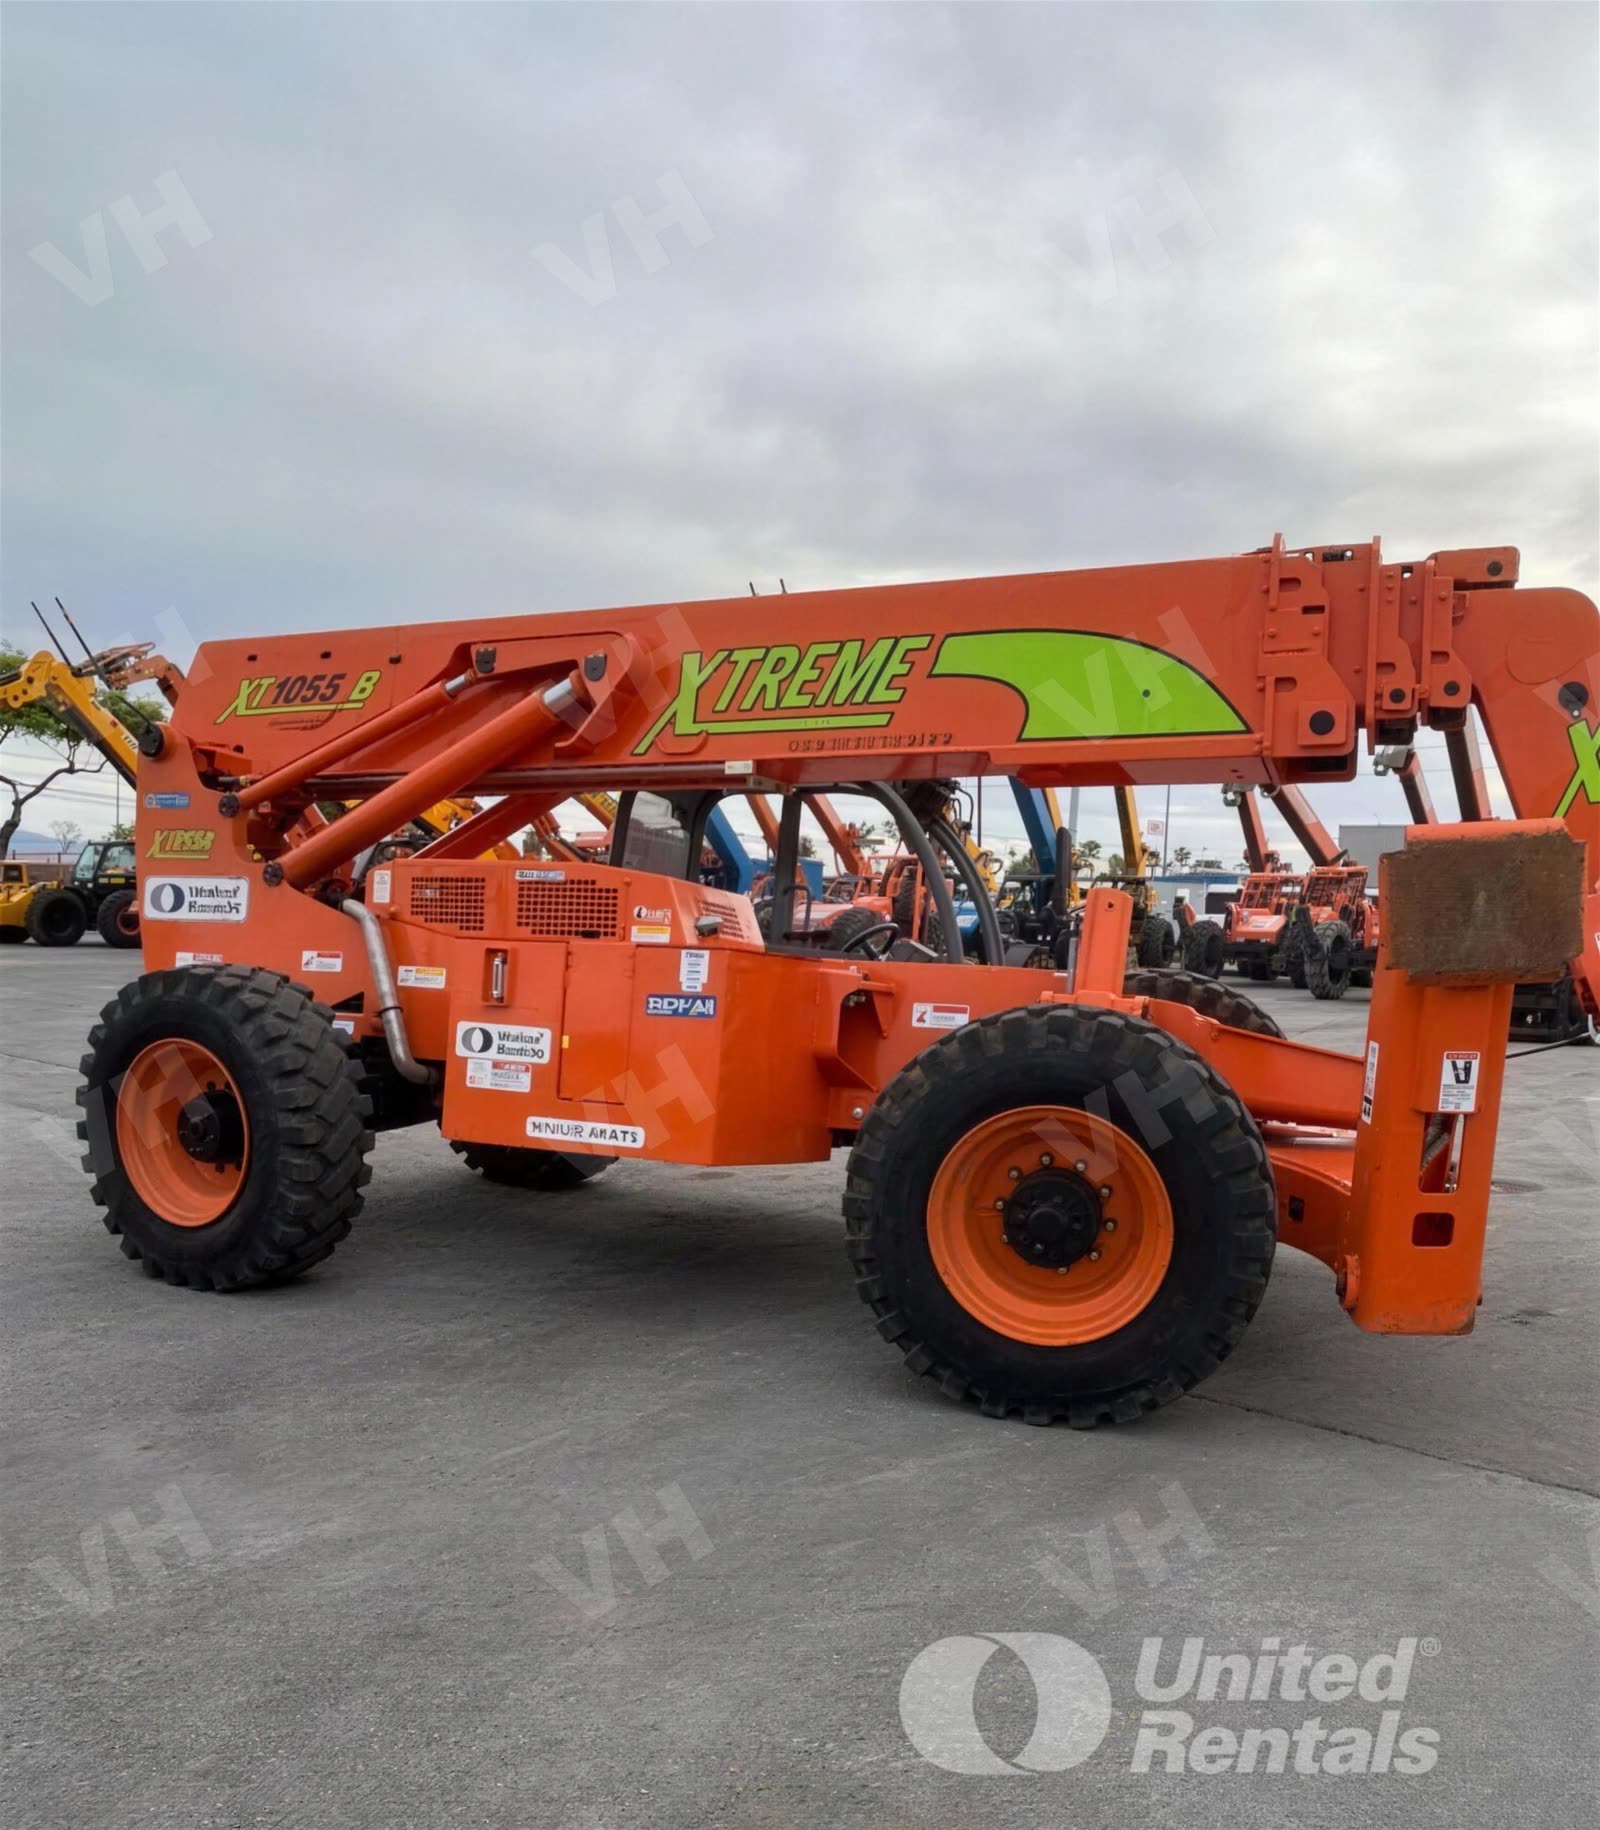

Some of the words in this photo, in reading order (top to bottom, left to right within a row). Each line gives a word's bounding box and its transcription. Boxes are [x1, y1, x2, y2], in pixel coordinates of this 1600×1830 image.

[214, 672, 347, 725] XT1055
[349, 669, 382, 701] B
[631, 633, 935, 755] XTREME
